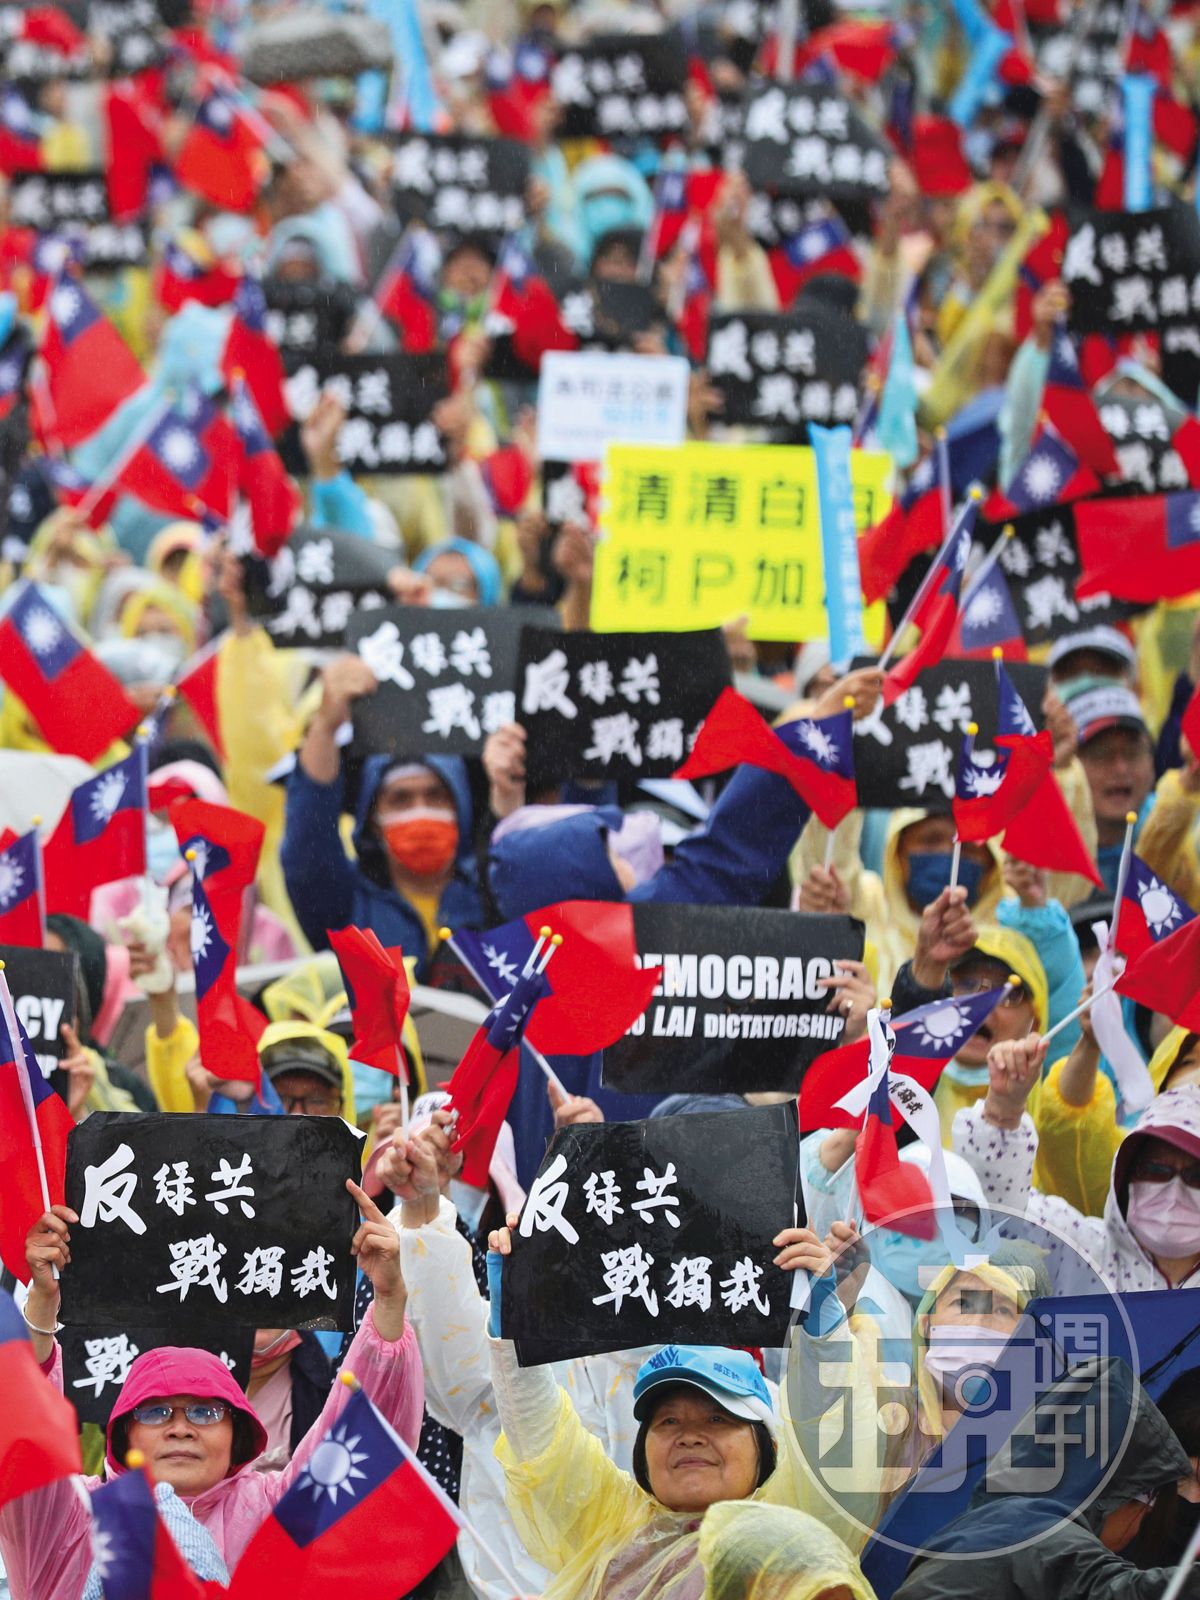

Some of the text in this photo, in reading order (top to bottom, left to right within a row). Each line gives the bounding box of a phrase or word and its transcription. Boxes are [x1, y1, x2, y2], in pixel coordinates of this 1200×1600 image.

[617, 549, 830, 606] 柯P加
[653, 1005, 696, 1037] LAI
[704, 1013, 845, 1040] DICTATORSHIP
[80, 1143, 255, 1234] 反綠共
[518, 1154, 682, 1243] 反綠共
[156, 1234, 338, 1303] 戰獨裁
[592, 1243, 771, 1318] 戰獨裁
